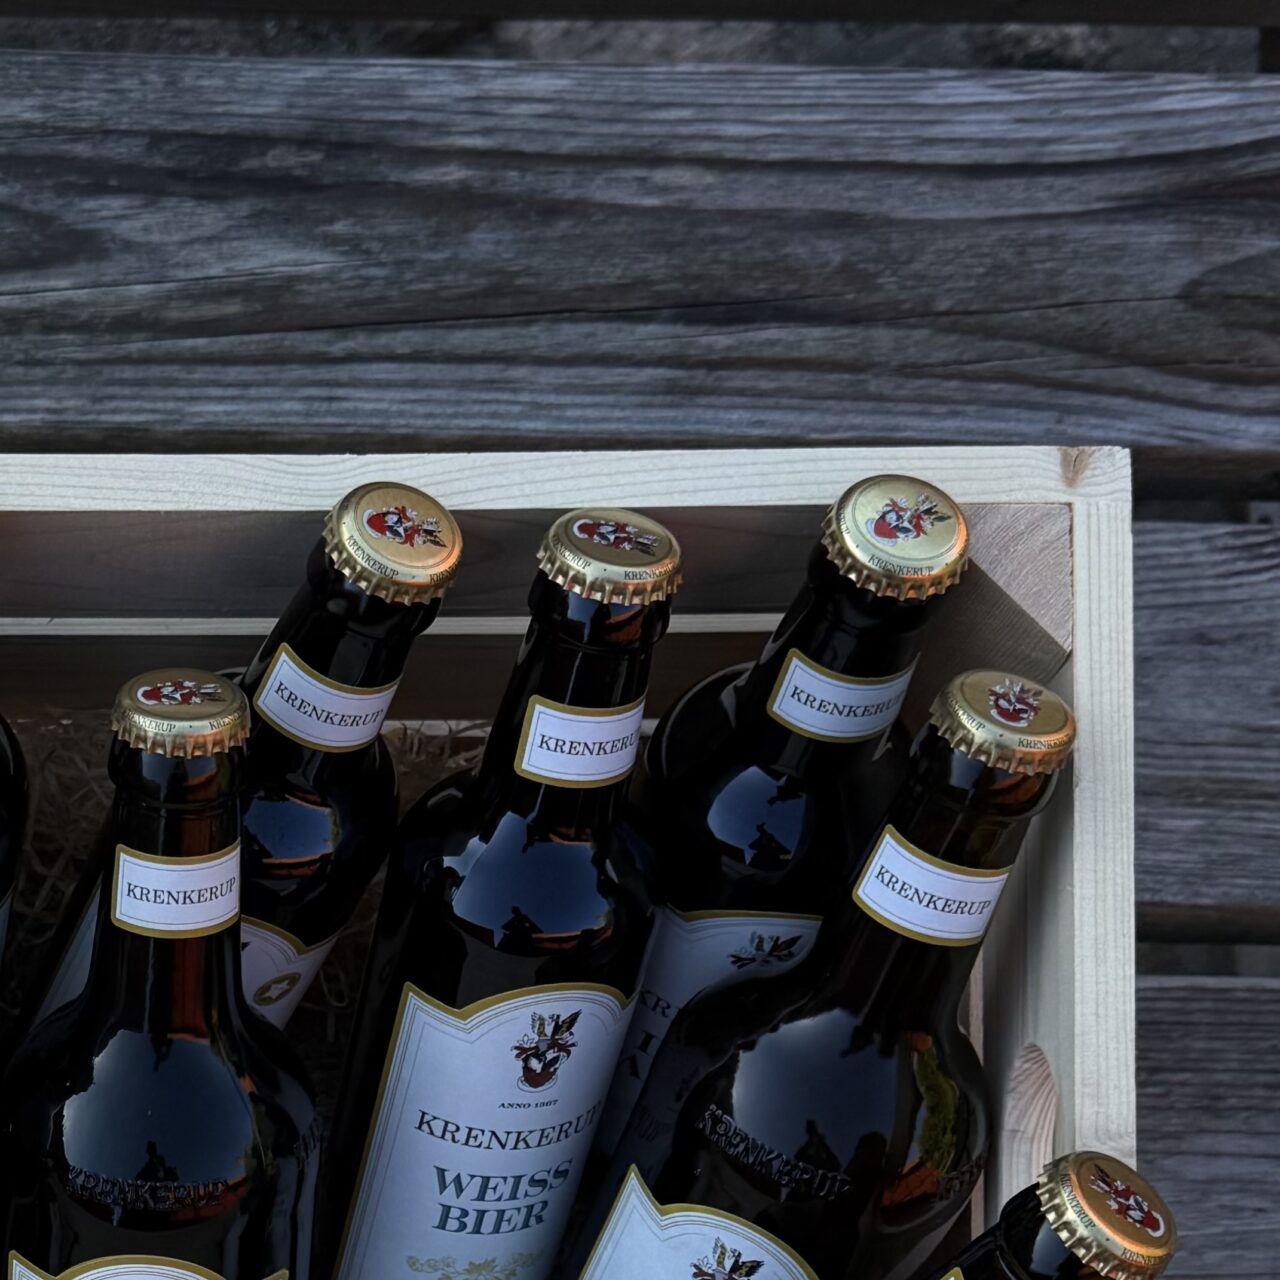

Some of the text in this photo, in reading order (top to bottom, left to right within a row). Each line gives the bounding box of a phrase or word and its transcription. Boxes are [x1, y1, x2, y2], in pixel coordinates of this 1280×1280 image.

[345, 534, 400, 581] KRENKERUP
[868, 554, 934, 577] KRENKERUP
[126, 876, 237, 906] KRENKERUP
[874, 864, 992, 916] KRENKERUP
[432, 1157, 574, 1204] WEISS
[431, 1200, 550, 1236] BIER
